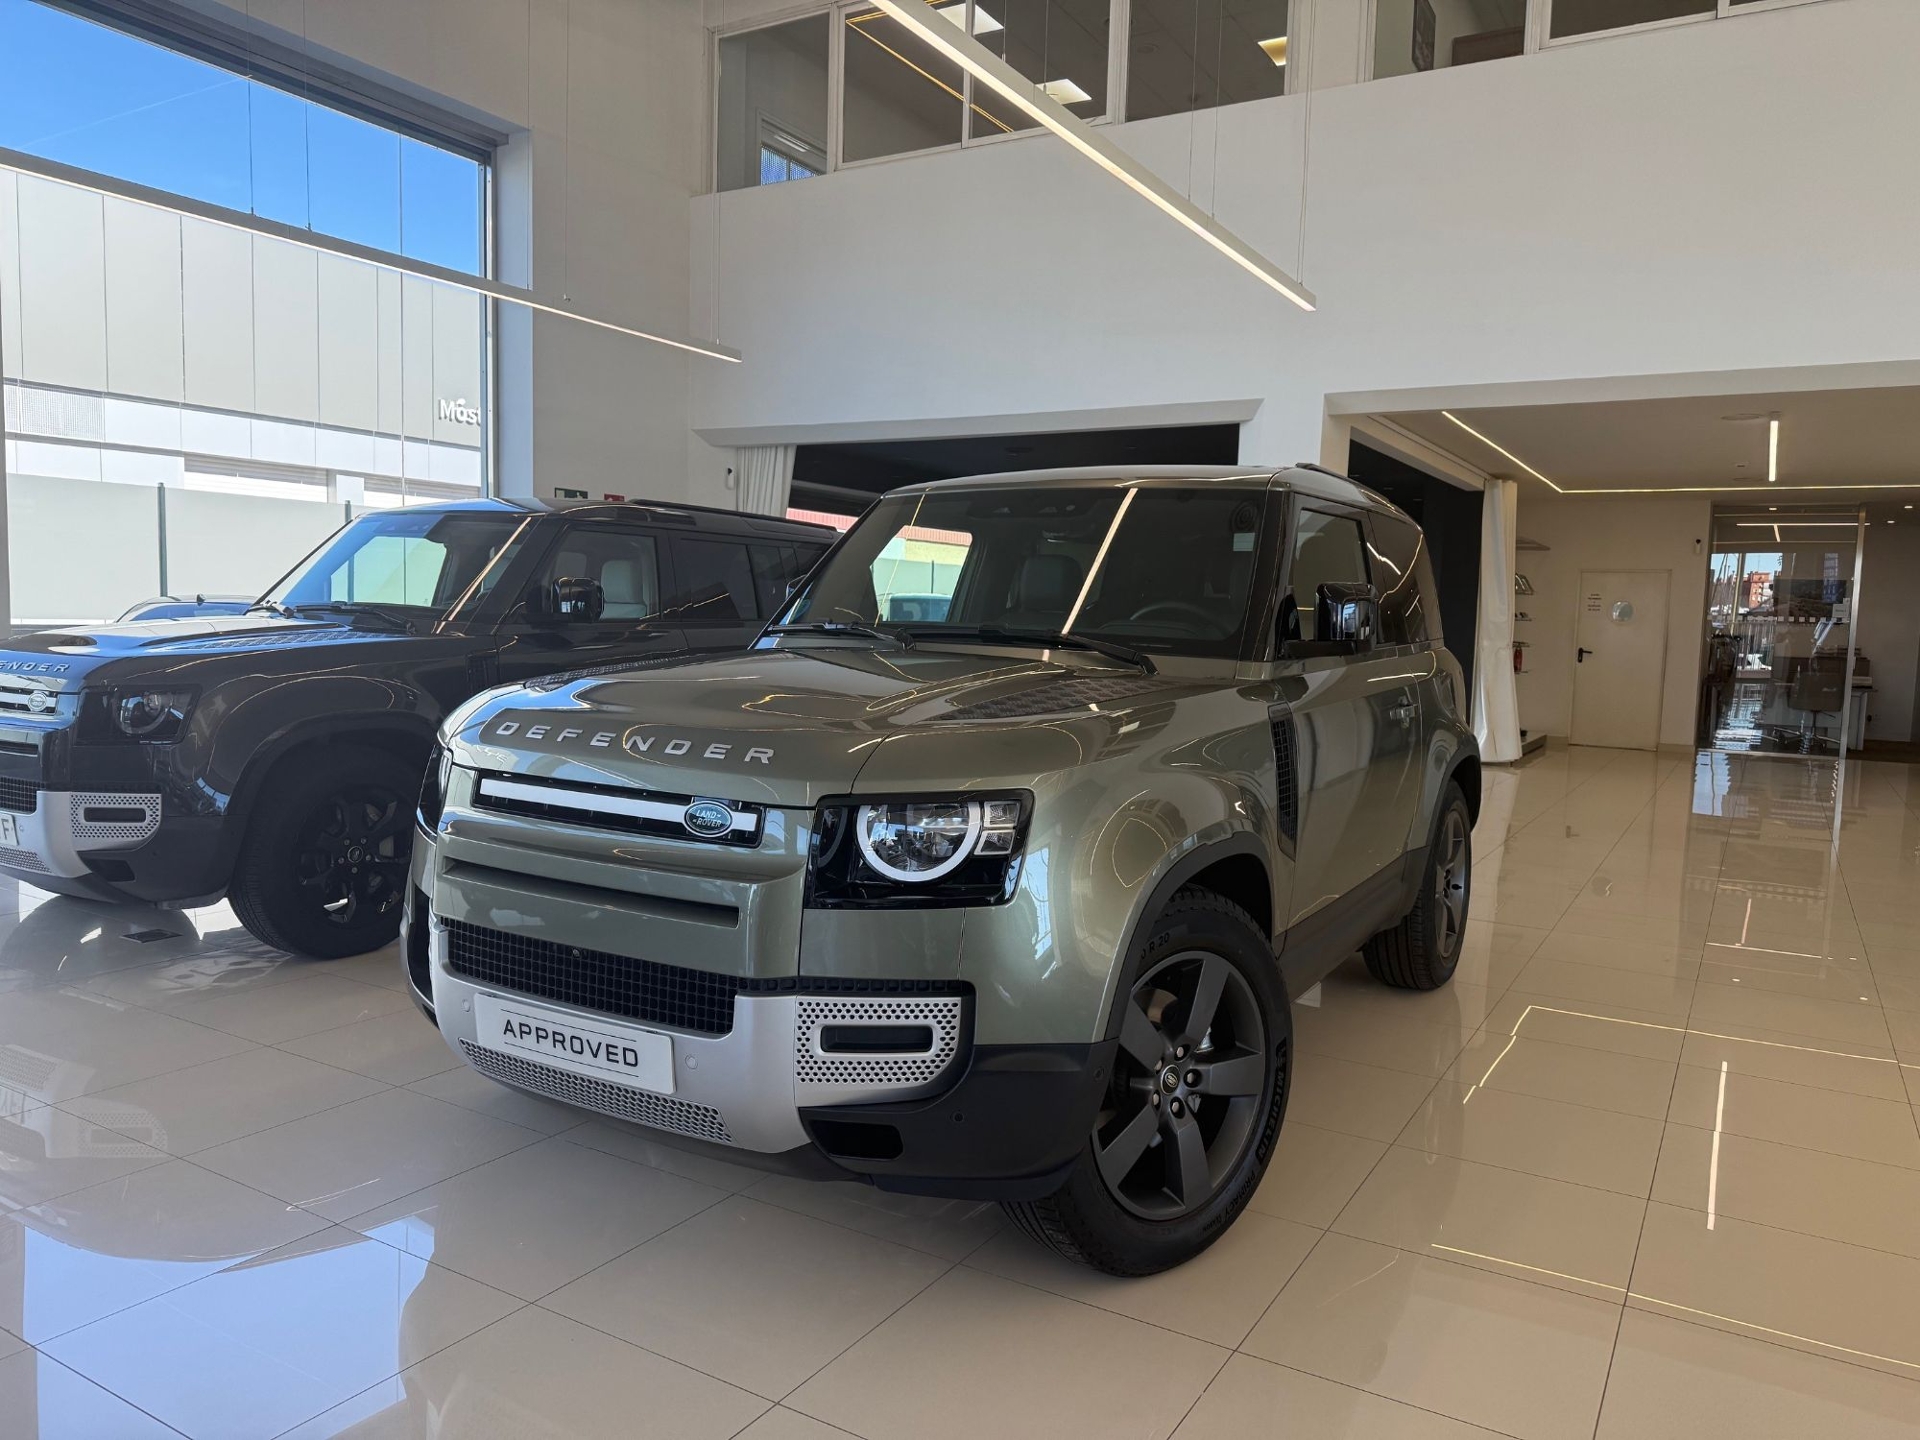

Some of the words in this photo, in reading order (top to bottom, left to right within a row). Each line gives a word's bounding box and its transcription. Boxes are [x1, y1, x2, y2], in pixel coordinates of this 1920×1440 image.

[496, 721, 775, 764] DEFENDER
[696, 809, 717, 819] LAND
[696, 817, 722, 827] ROVER
[503, 1019, 638, 1067] APPROVED
[1257, 1070, 1286, 1158] MICHELIN
